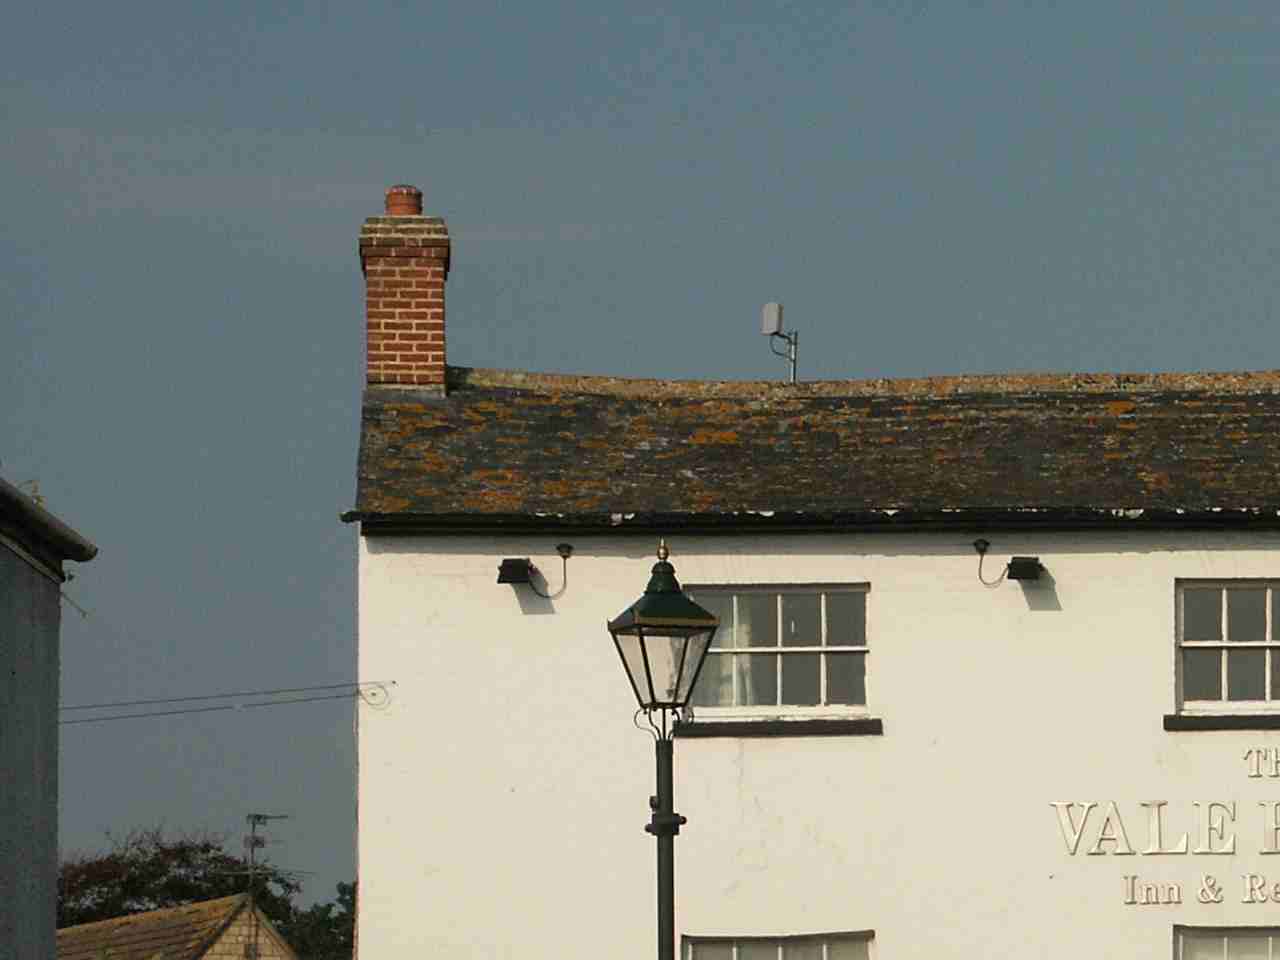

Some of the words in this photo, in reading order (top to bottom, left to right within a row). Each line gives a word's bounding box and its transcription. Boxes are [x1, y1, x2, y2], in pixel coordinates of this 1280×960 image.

[1050, 799, 1237, 856] VALE
[1122, 875, 1183, 905] Inn
[1197, 875, 1224, 904] &
